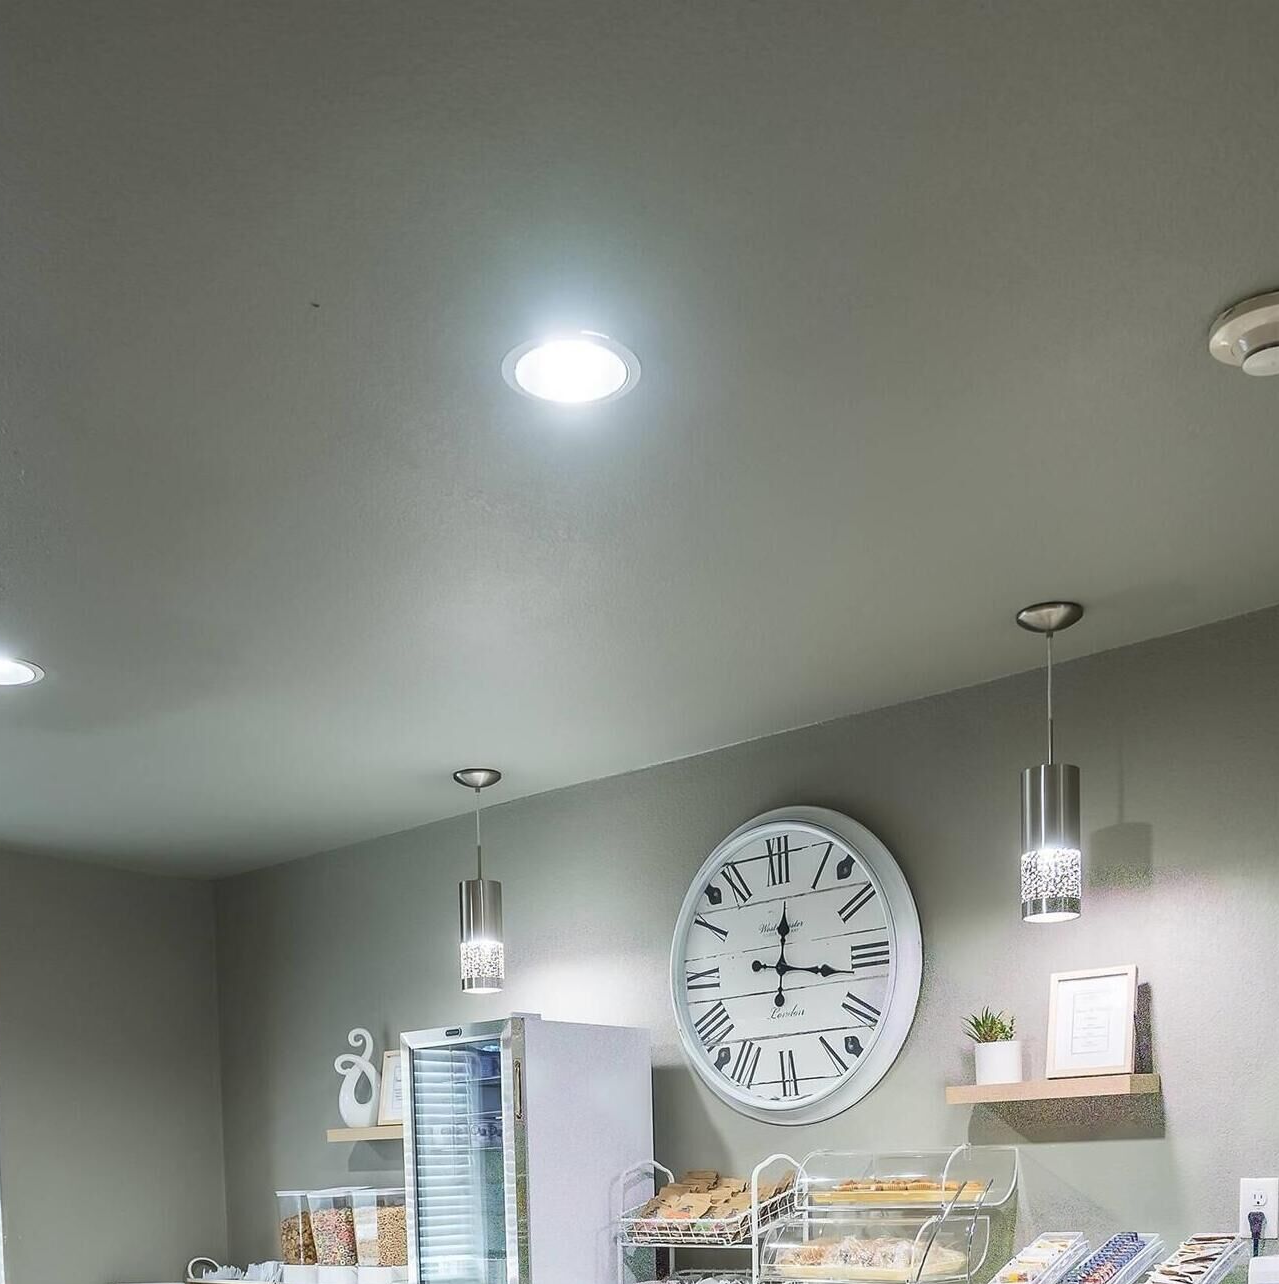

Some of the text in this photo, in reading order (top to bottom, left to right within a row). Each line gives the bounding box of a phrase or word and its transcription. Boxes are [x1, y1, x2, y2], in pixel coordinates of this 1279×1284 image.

[766, 835, 790, 887] XII
[811, 842, 834, 890] I
[721, 862, 753, 909] XI
[837, 882, 876, 923] II
[694, 913, 729, 942] X
[851, 941, 889, 969] III
[686, 967, 720, 990] IX
[694, 1001, 734, 1053] VIII
[767, 1004, 805, 1020] London
[841, 992, 881, 1031] IV
[731, 1040, 761, 1089] VII
[779, 1050, 799, 1097] VI
[819, 1036, 849, 1076] V
